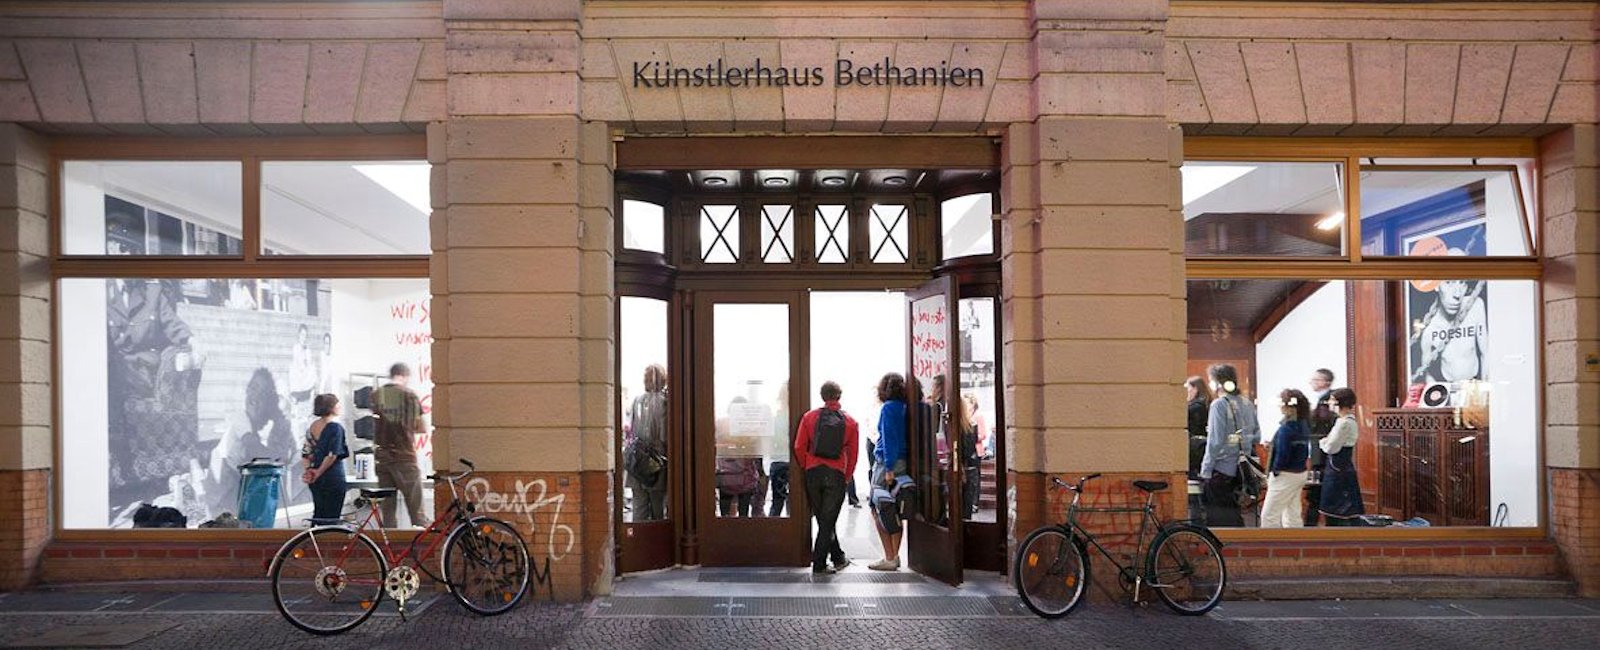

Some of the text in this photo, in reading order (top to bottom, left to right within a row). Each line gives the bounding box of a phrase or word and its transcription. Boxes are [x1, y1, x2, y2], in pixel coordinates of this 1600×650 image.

[633, 57, 984, 88] Künstlerhaus Bethanien
[1431, 325, 1476, 341] POESIE
